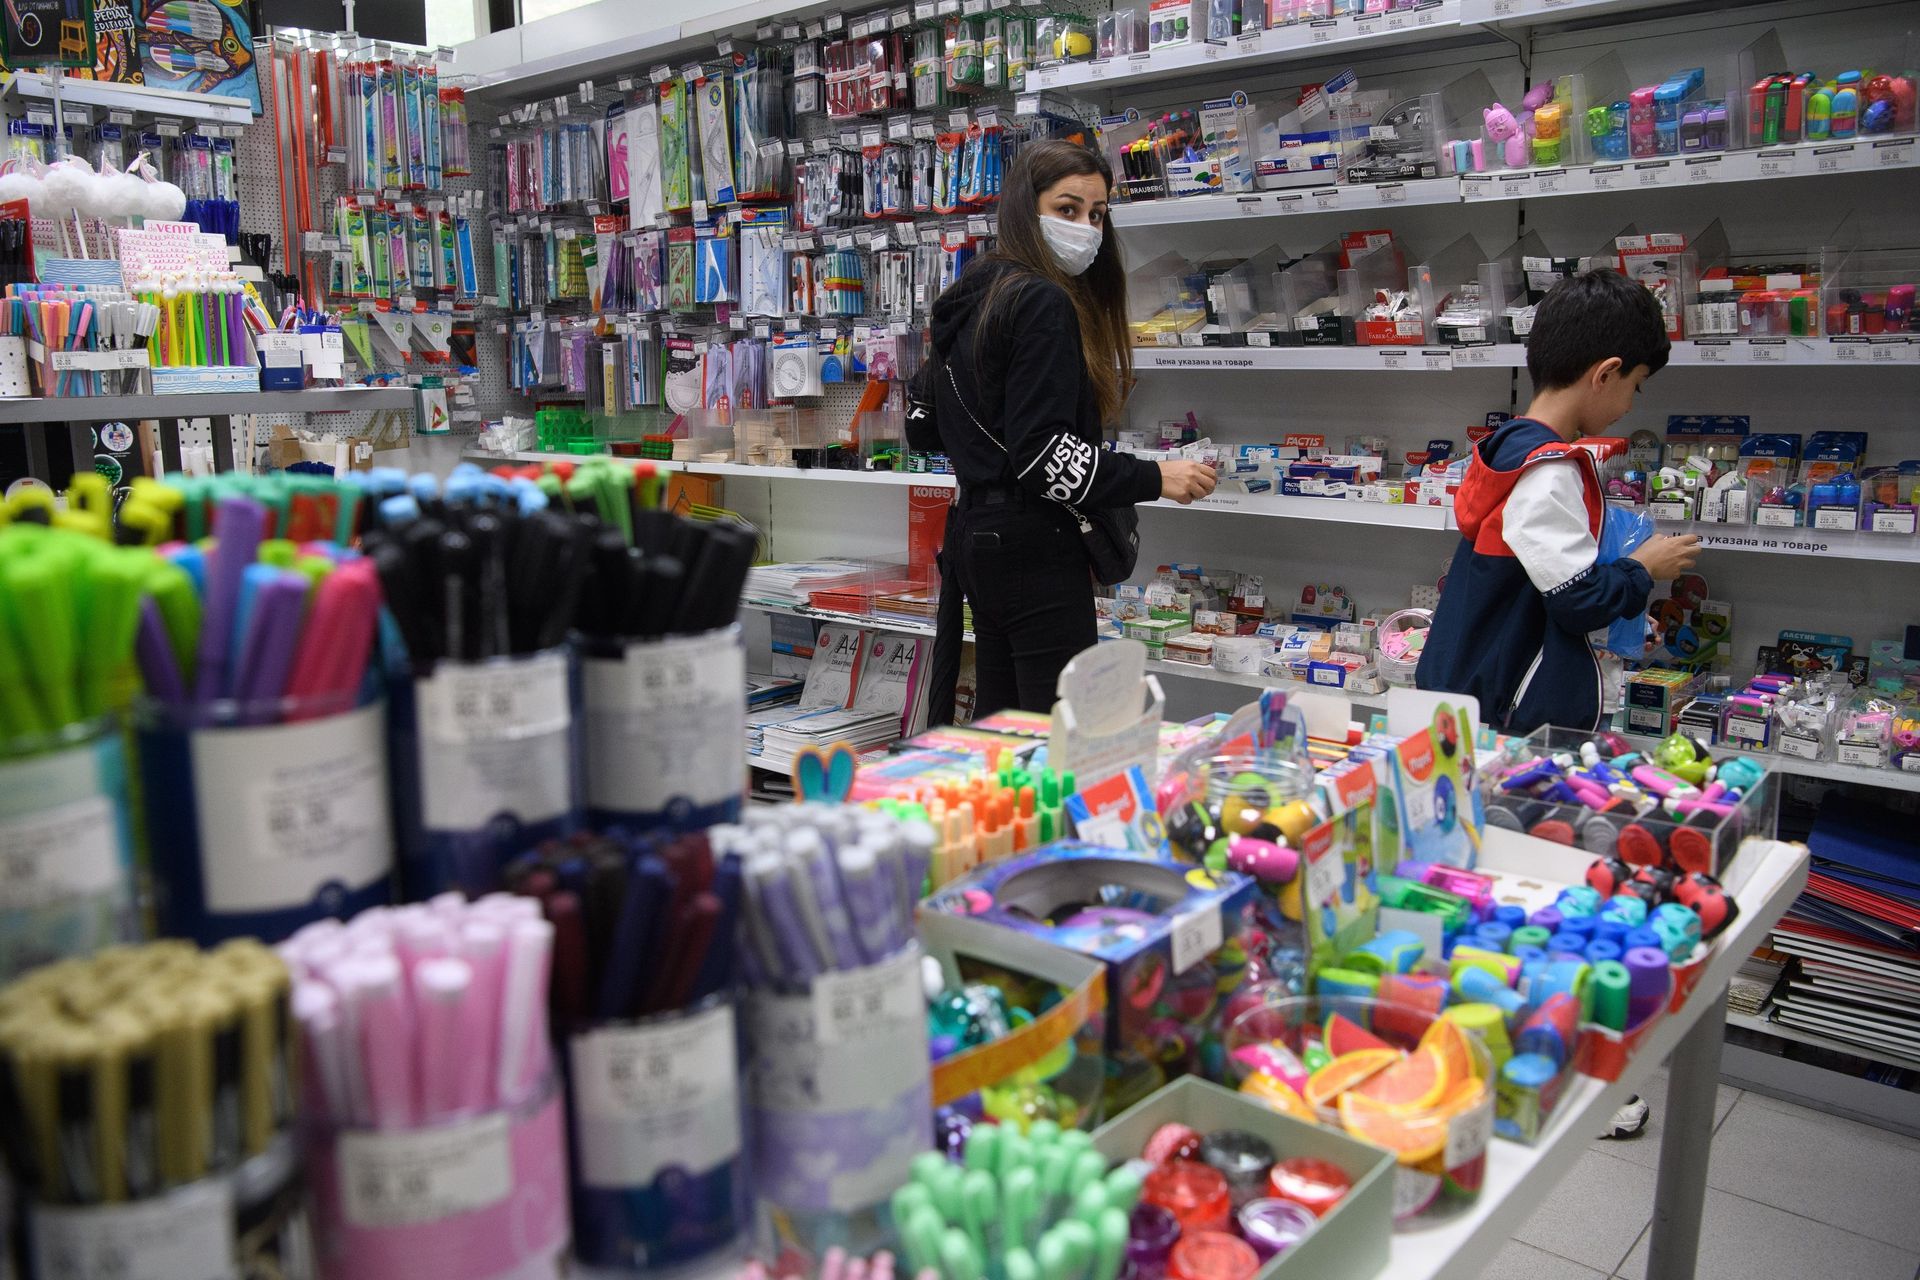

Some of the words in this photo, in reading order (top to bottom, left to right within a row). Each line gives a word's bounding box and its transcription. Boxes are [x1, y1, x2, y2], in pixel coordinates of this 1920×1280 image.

[1129, 185, 1164, 195] BRAUBERG
[148, 222, 197, 234] deVENTE
[1155, 357, 1176, 366] Цена
[1224, 359, 1254, 367] товаре
[1286, 436, 1321, 447] FACTIS
[1707, 535, 1759, 547] указана
[1762, 540, 1778, 548] на
[1783, 541, 1828, 552] товаре
[835, 634, 859, 656] A4
[890, 643, 916, 665] A4
